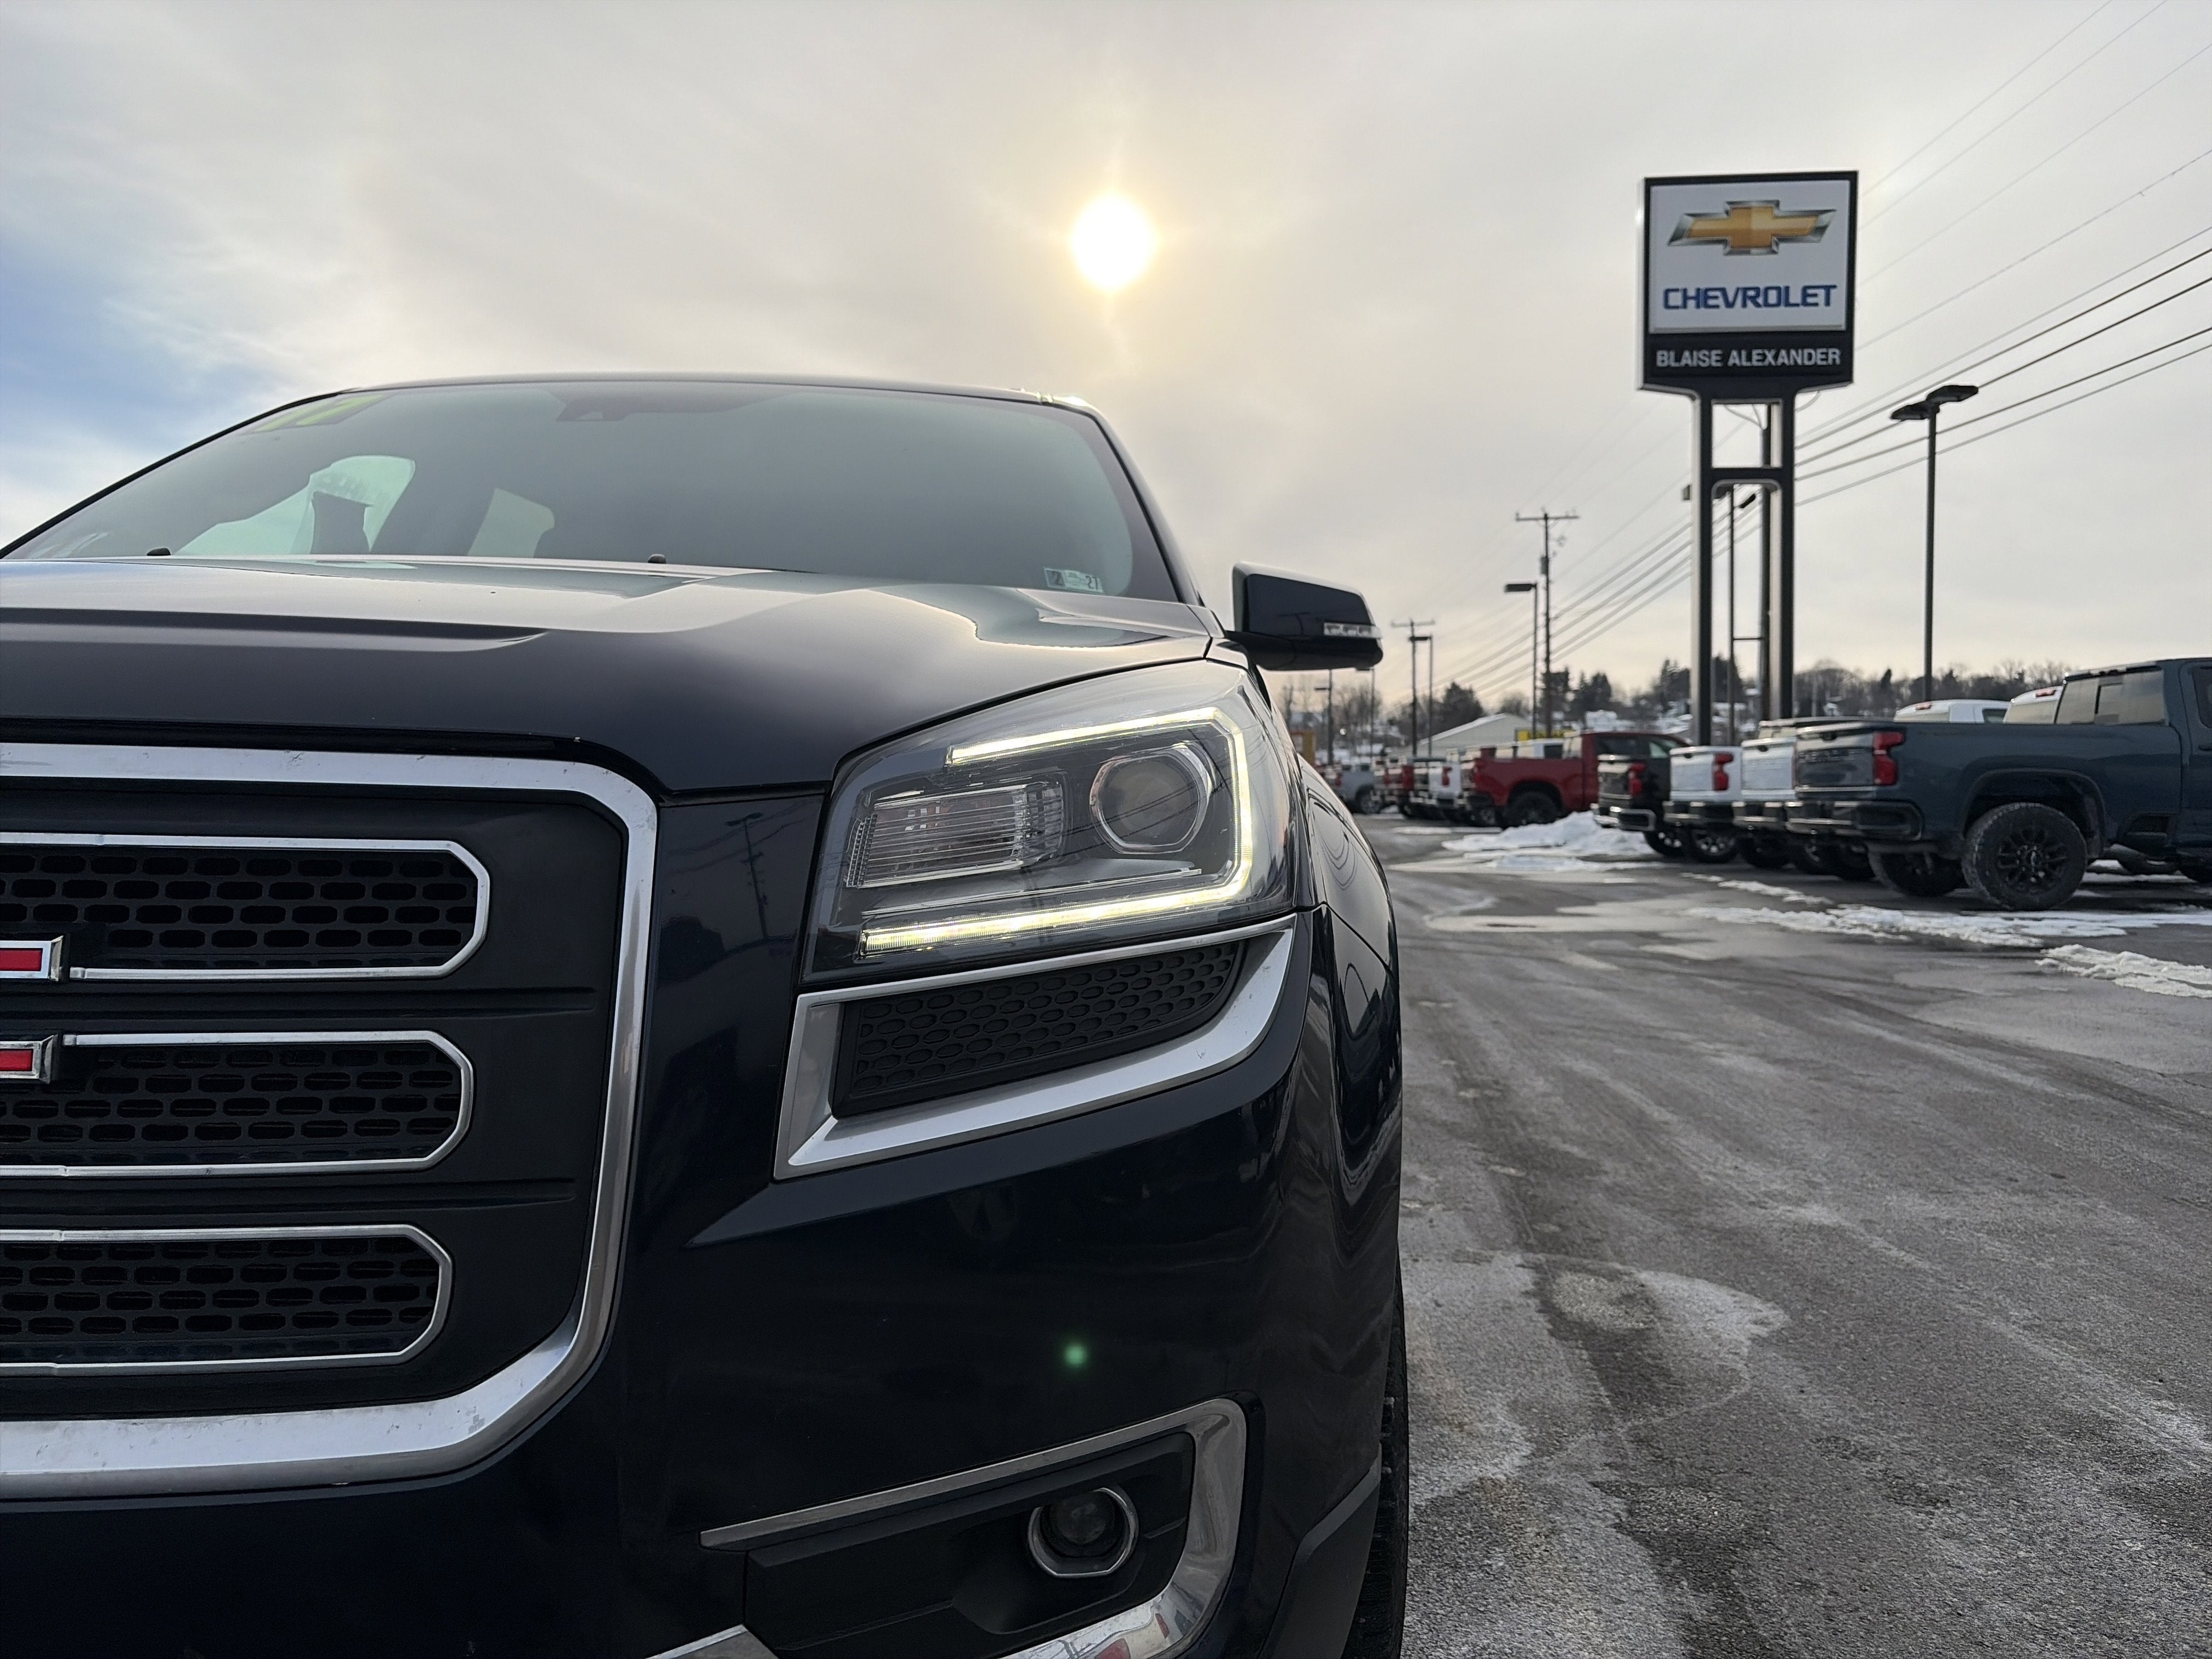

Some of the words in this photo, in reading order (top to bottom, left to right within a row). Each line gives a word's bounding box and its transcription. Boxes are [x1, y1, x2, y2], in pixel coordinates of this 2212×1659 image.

[1663, 285, 1837, 309] CHEVROLET
[1656, 349, 1722, 367] BLAISE
[1728, 348, 1841, 366] ALEXANDER
